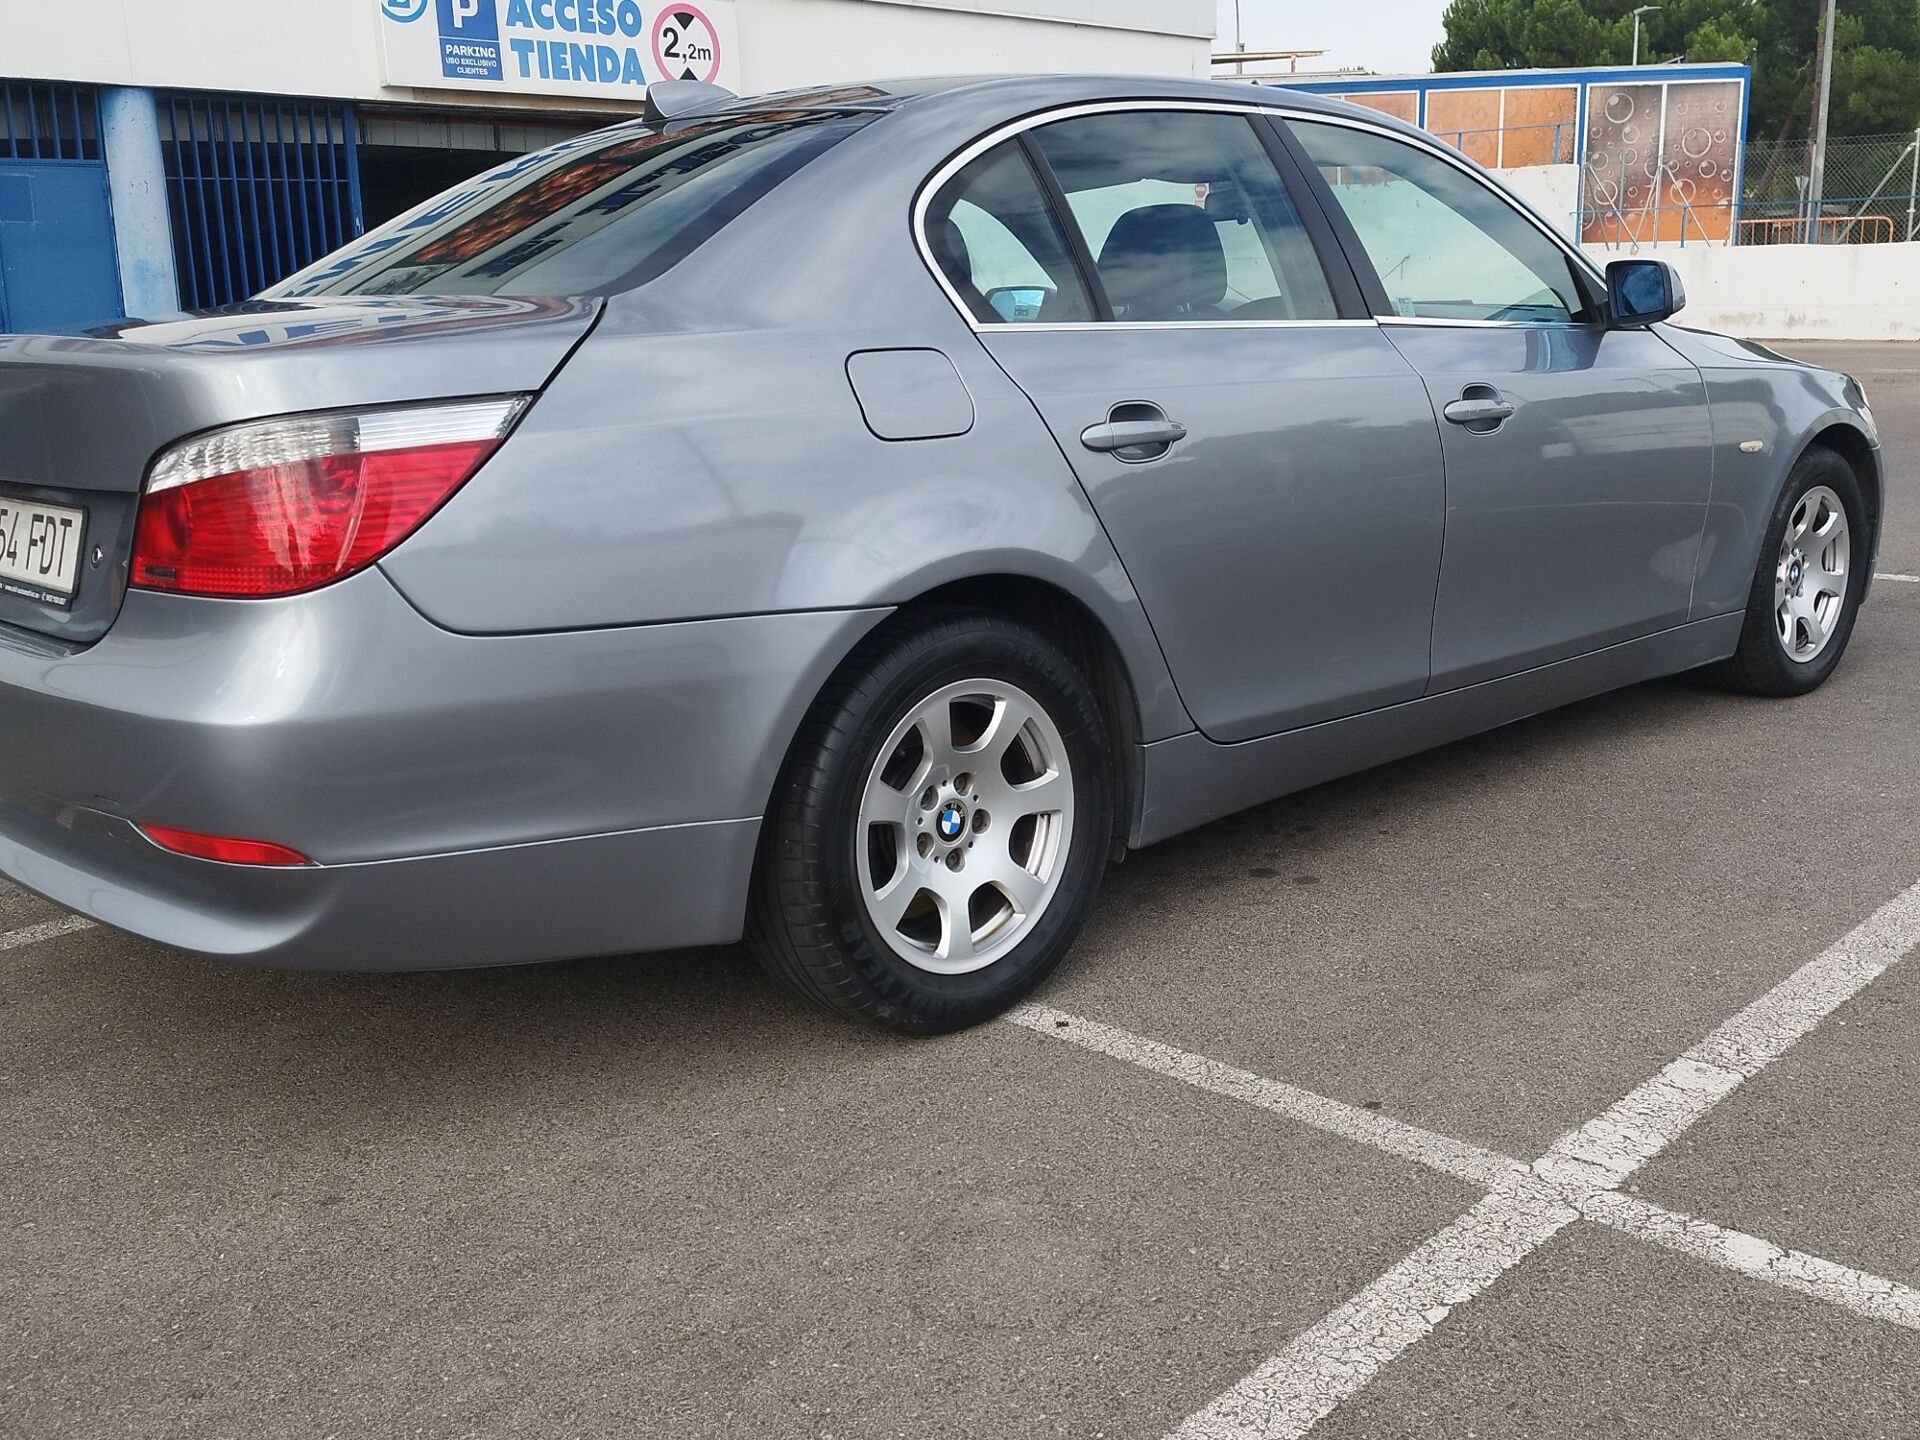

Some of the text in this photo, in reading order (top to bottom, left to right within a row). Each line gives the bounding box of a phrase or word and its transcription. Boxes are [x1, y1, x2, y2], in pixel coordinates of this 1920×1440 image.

[452, 0, 478, 28] P
[506, 0, 642, 38] ACCESO
[446, 45, 496, 58] PARKING
[510, 38, 646, 85] TIENDA
[663, 27, 711, 64] 2,2m
[446, 57, 497, 68] USO EXCLUSIVO
[457, 67, 488, 76] CLIENTES
[26, 514, 73, 578] FDT
